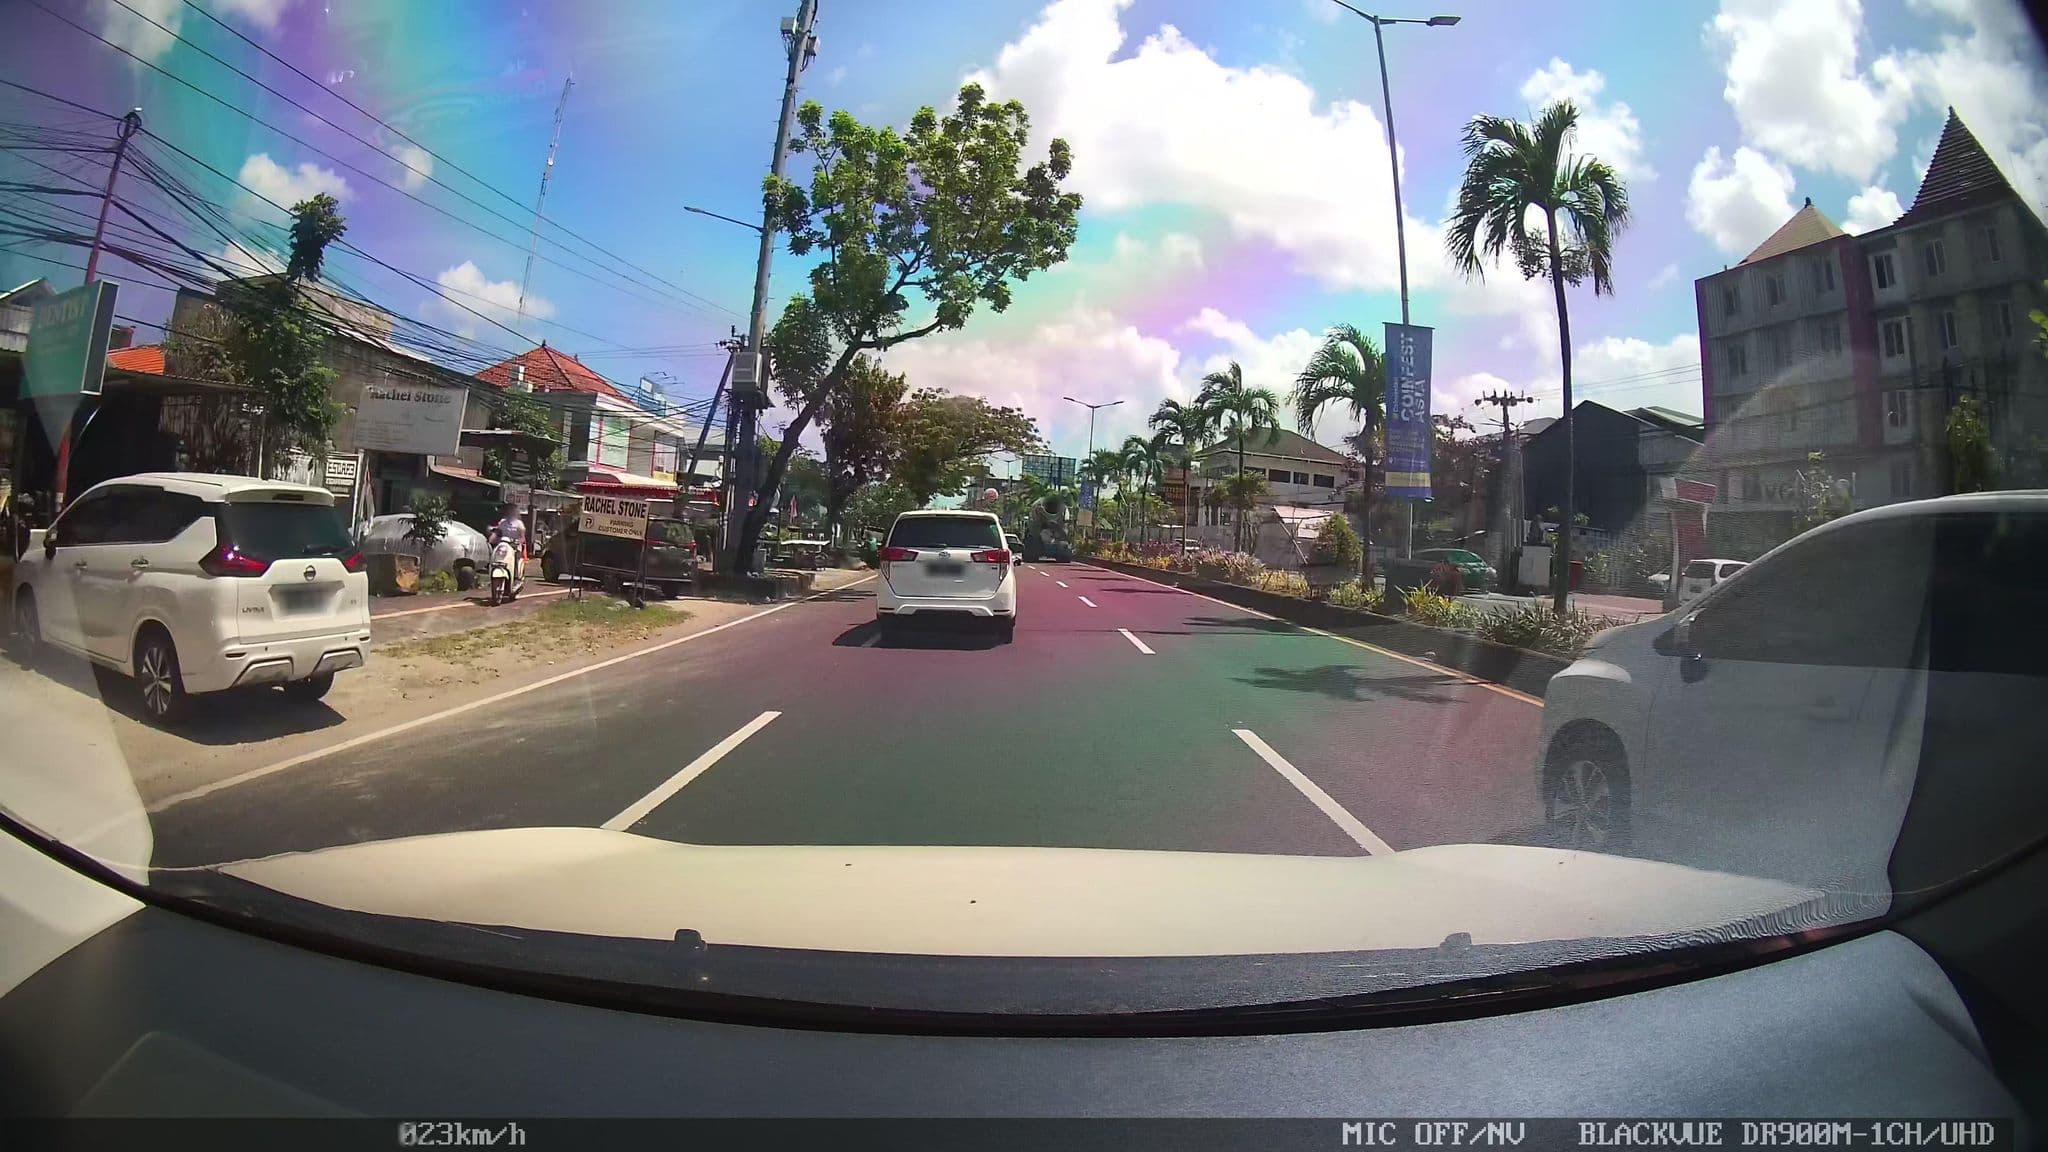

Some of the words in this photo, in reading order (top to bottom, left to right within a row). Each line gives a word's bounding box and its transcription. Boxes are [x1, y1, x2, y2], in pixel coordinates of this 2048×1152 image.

[1400, 332, 1415, 422] COINFEST
[1414, 379, 1426, 425] ASIA
[583, 496, 616, 515] RACHEL
[617, 501, 647, 519] STONE
